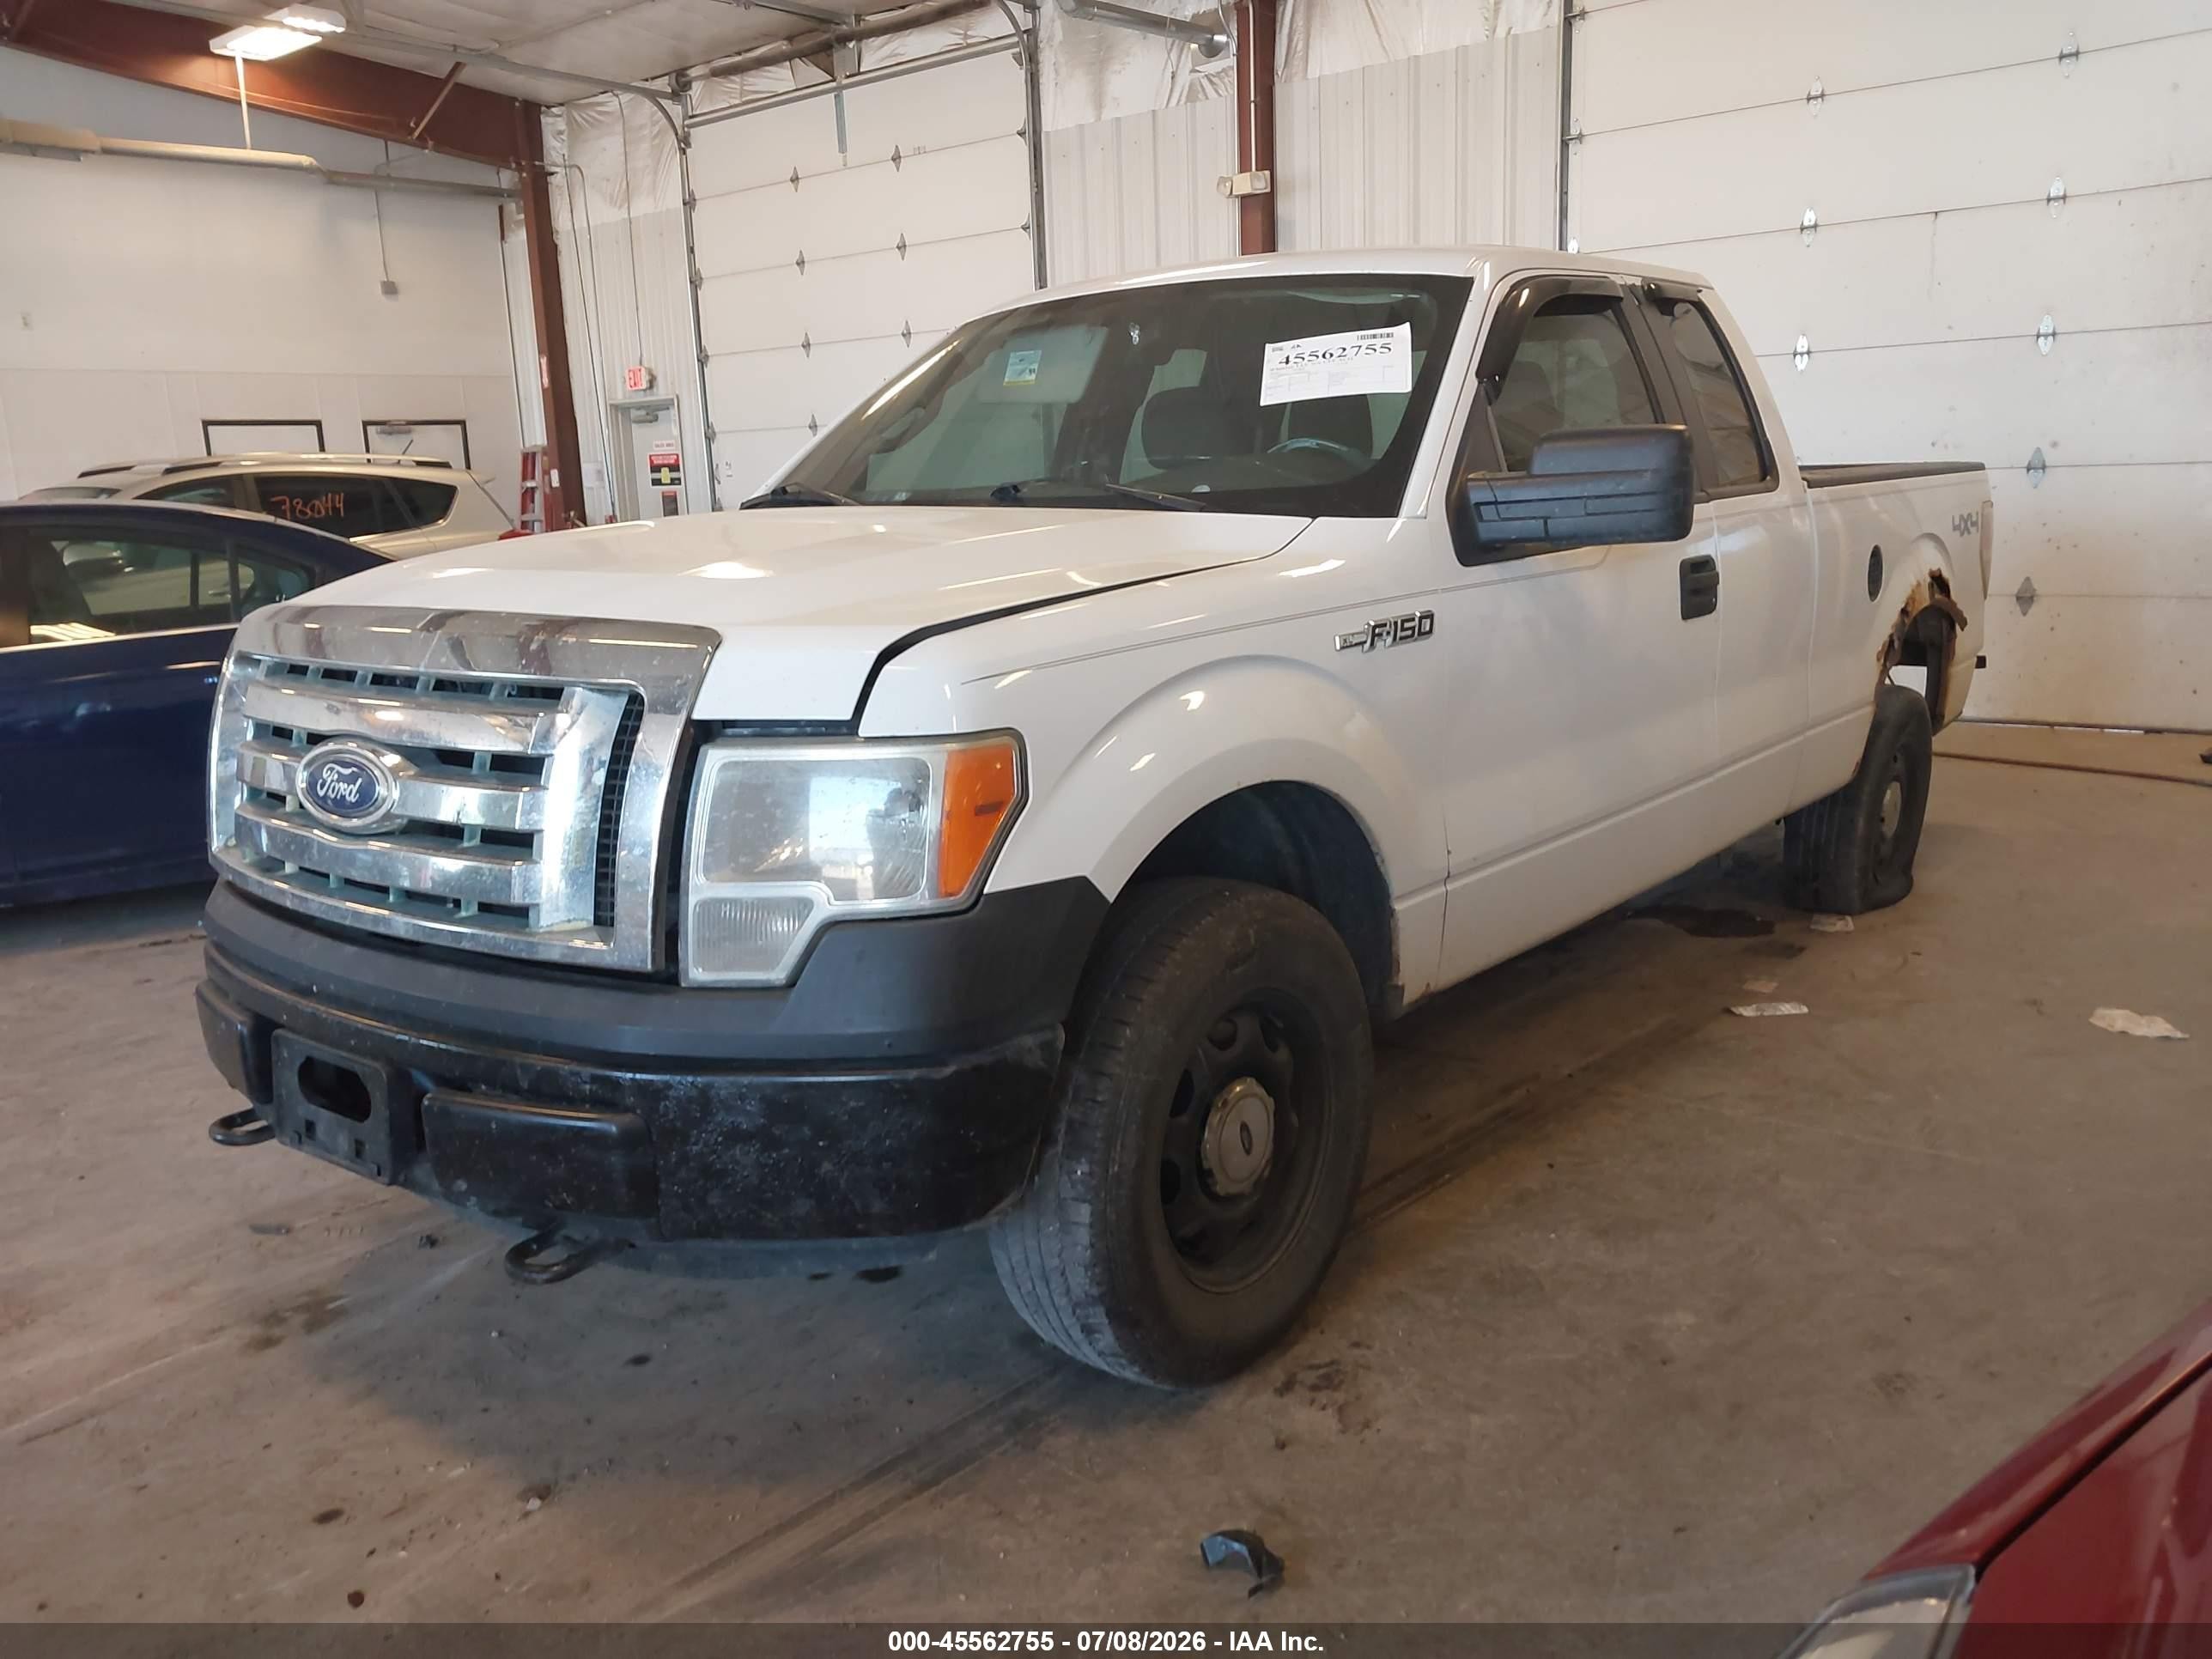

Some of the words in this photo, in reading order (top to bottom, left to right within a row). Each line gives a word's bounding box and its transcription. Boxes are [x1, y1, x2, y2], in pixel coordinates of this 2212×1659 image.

[1279, 343, 1392, 365] 45562755
[628, 368, 642, 389] EXIT
[317, 763, 362, 803] Ford
